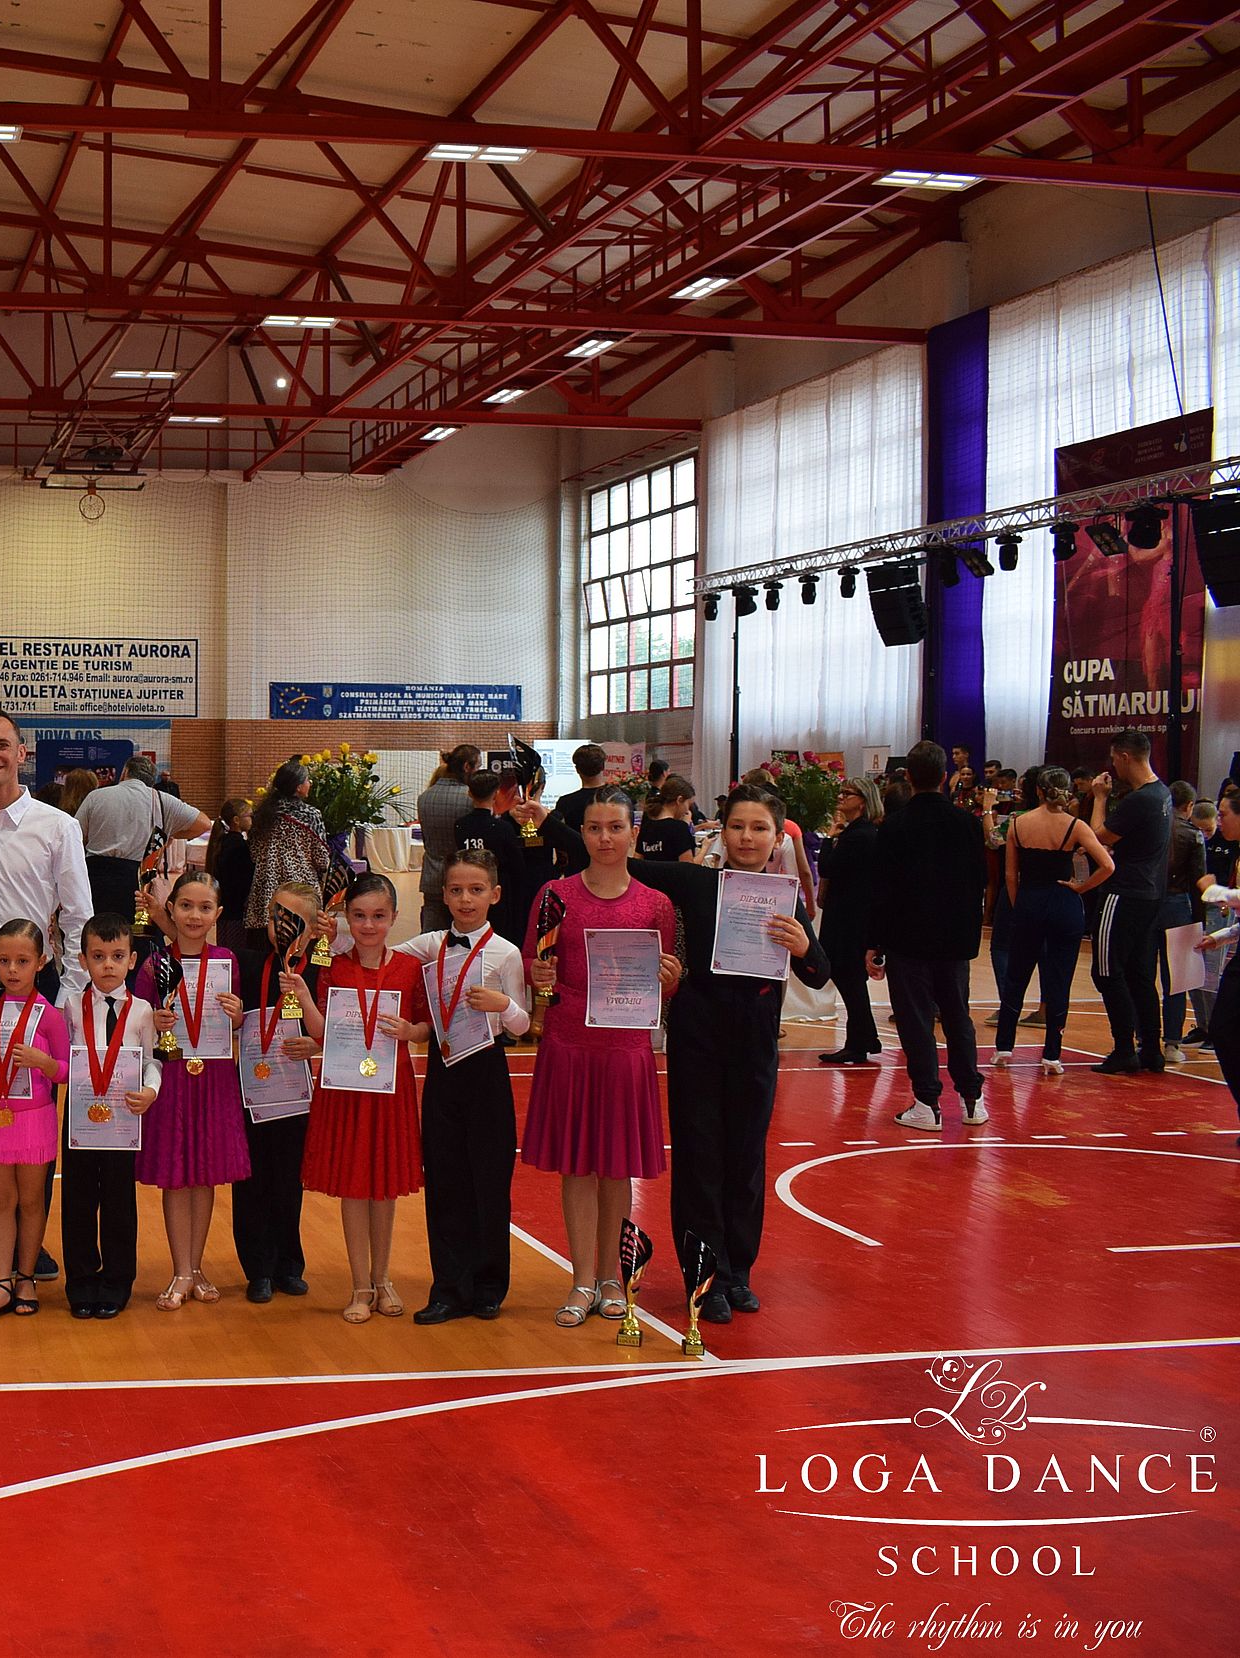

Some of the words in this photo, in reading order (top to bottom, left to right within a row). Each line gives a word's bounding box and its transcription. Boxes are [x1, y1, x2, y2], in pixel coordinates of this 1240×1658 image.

[22, 642, 124, 657] RESTAURANT
[128, 644, 191, 658] AURORA
[62, 660, 79, 671] DE
[83, 660, 133, 671] TURISM
[1063, 658, 1115, 684] CUPA
[11, 672, 29, 682] Fax:
[30, 672, 84, 682] 0261-714.946
[86, 673, 110, 683] Email:
[112, 673, 194, 684] aurora@aurora-sm.ro
[3, 684, 68, 699] VIOLETA
[136, 689, 184, 700] JUPITER
[53, 702, 78, 712] Email:
[80, 702, 165, 713] office@hotelvioleta.ro
[1070, 725, 1096, 735] Concurs
[1137, 723, 1156, 733] dans
[463, 838, 484, 850] 138
